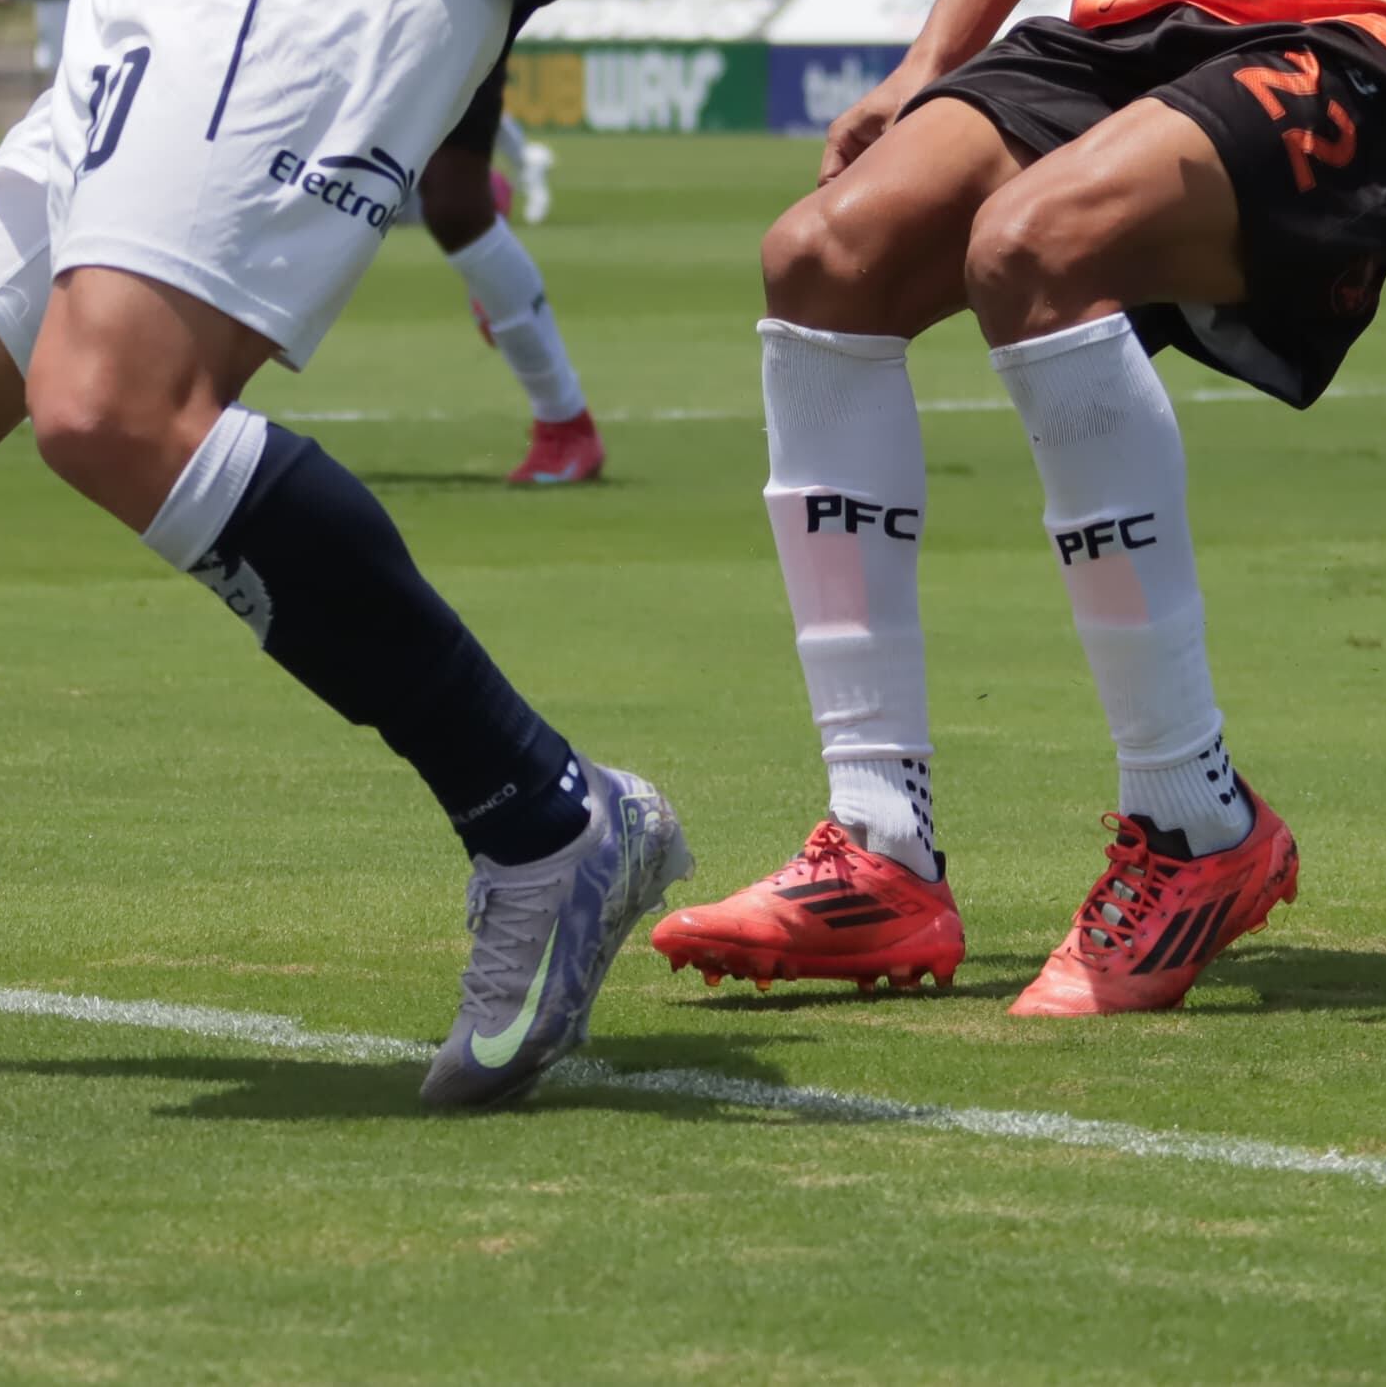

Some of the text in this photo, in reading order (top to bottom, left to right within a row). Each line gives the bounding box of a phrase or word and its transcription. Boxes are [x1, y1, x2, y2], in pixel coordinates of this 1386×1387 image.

[1232, 50, 1358, 194] 22
[805, 494, 919, 542] PFC
[1055, 512, 1158, 566] PFC
